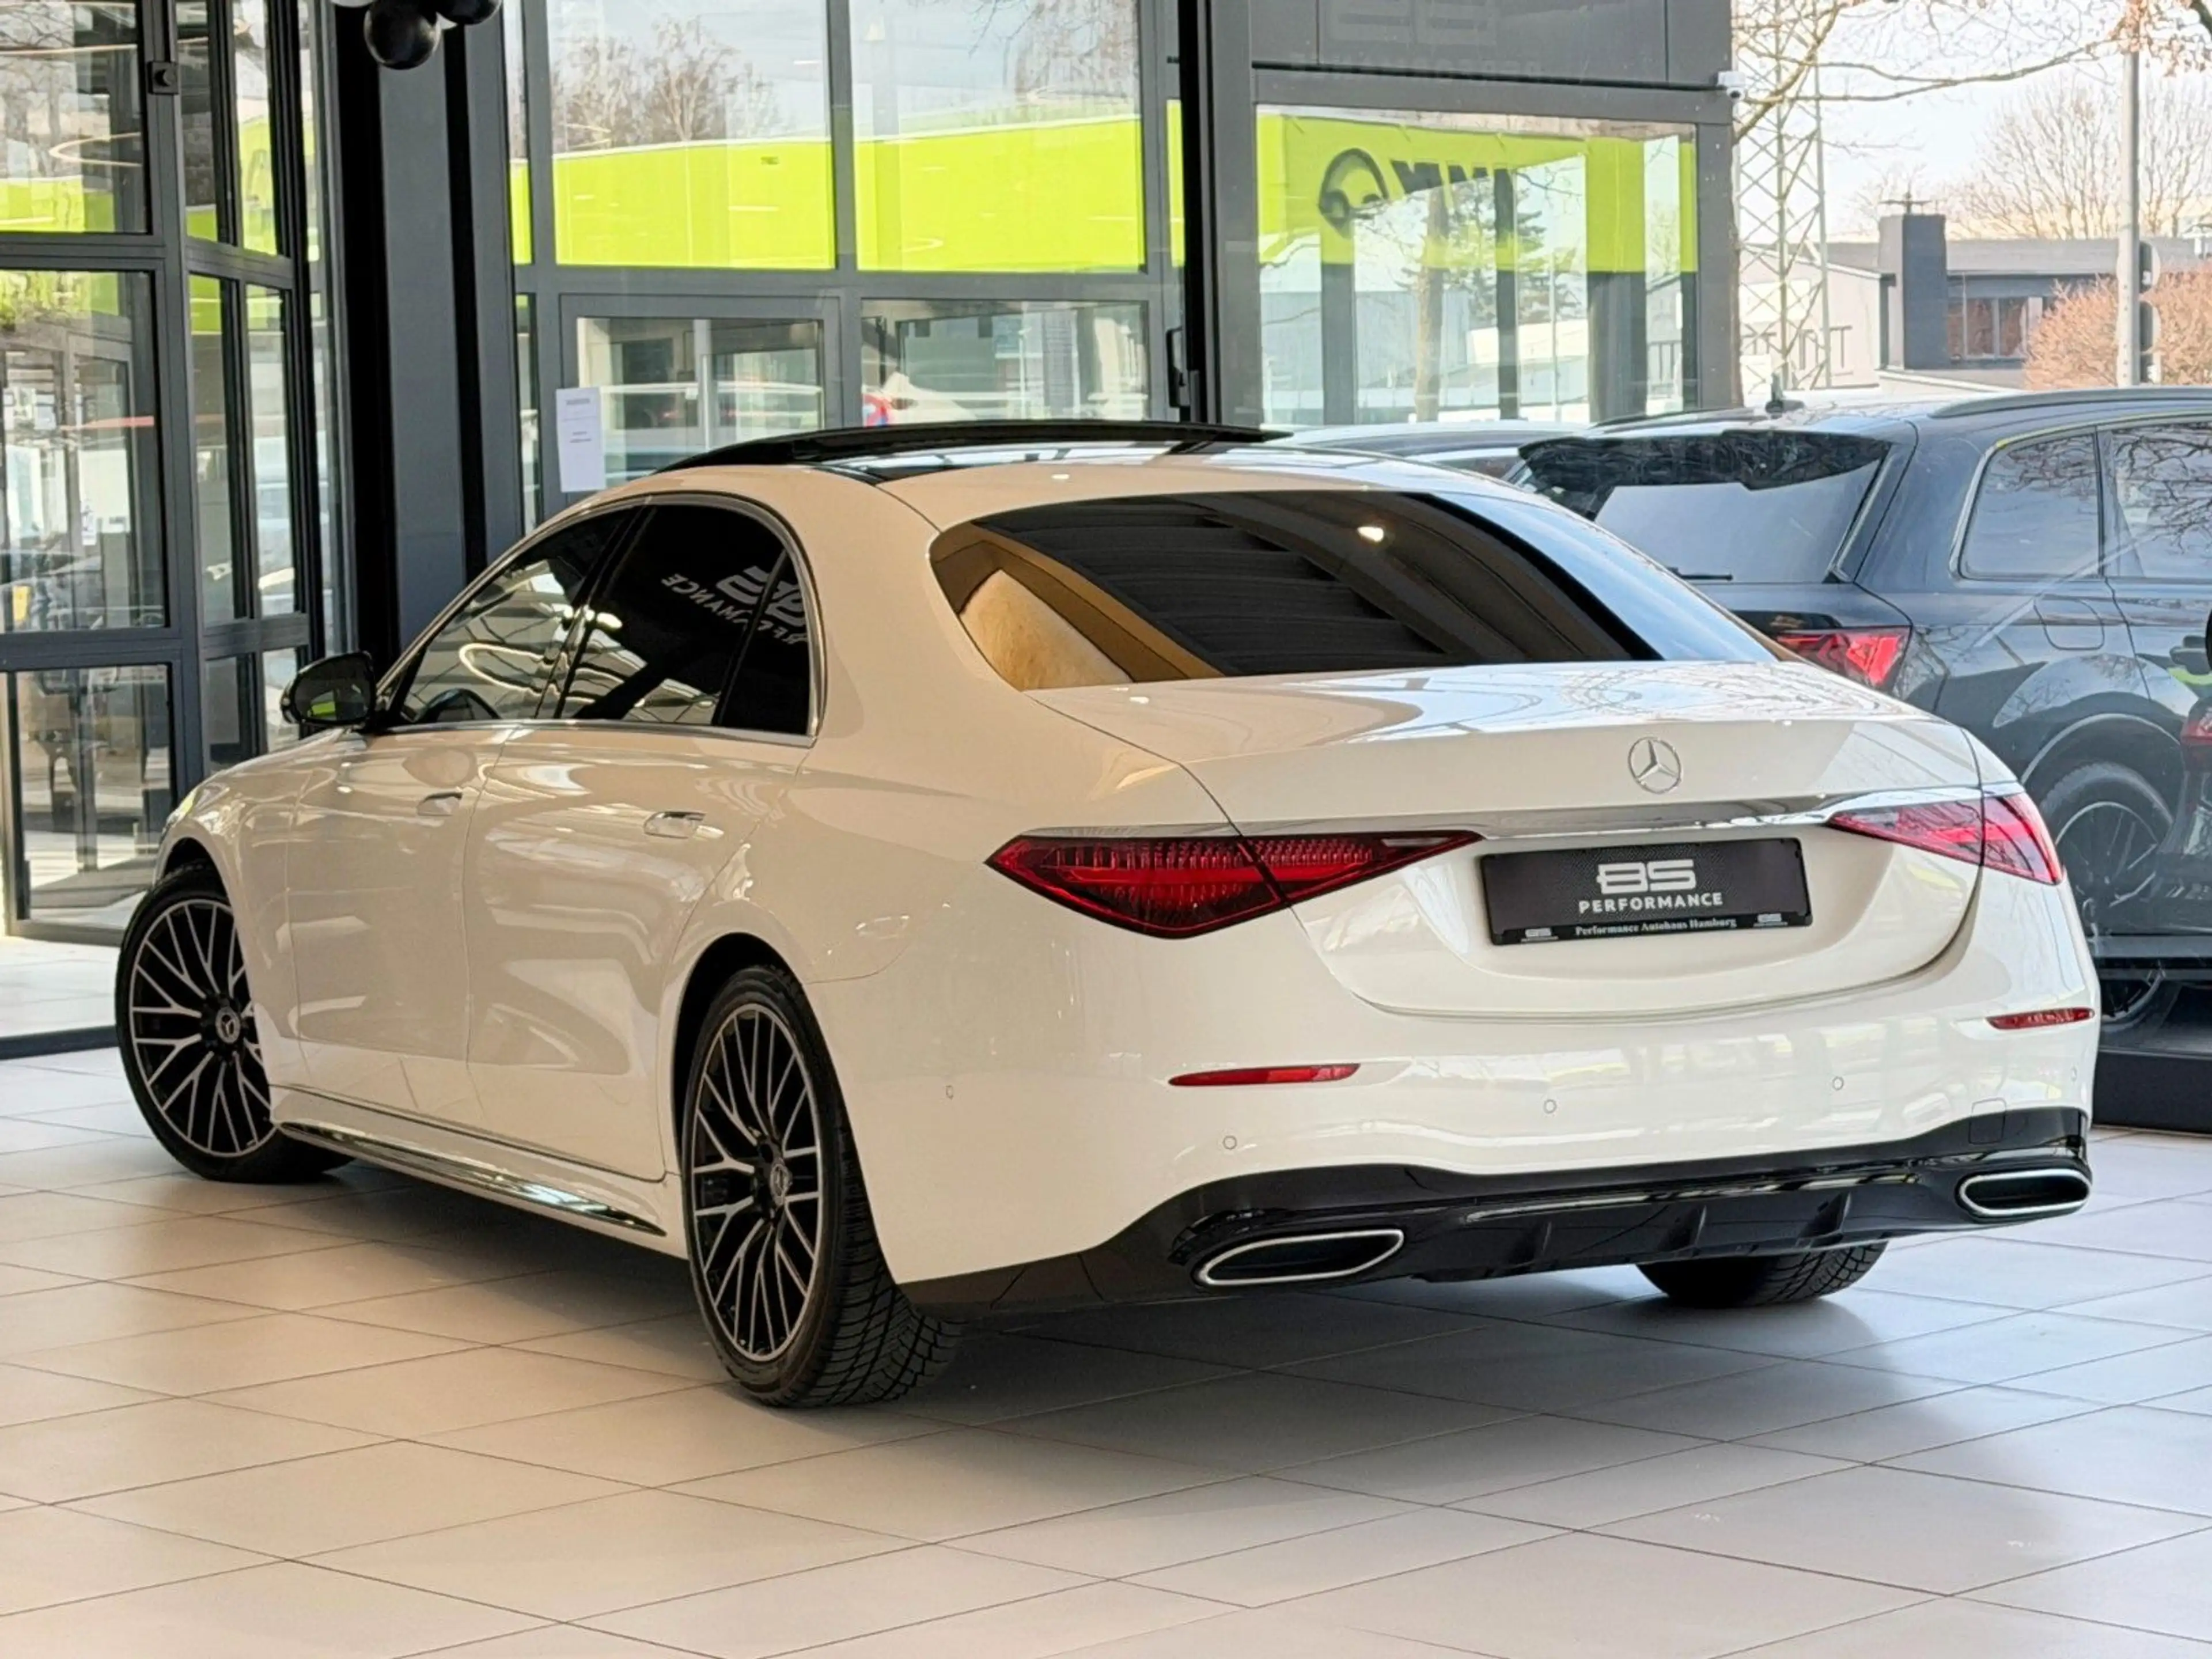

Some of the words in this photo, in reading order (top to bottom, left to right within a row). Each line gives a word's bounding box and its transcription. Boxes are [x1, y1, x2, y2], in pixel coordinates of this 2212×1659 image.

[1578, 892, 1724, 914] PERFORMANCE
[1575, 925, 1640, 936] Performance
[1642, 921, 1688, 931] Autohaus
[1689, 918, 1737, 929] Hamburg
